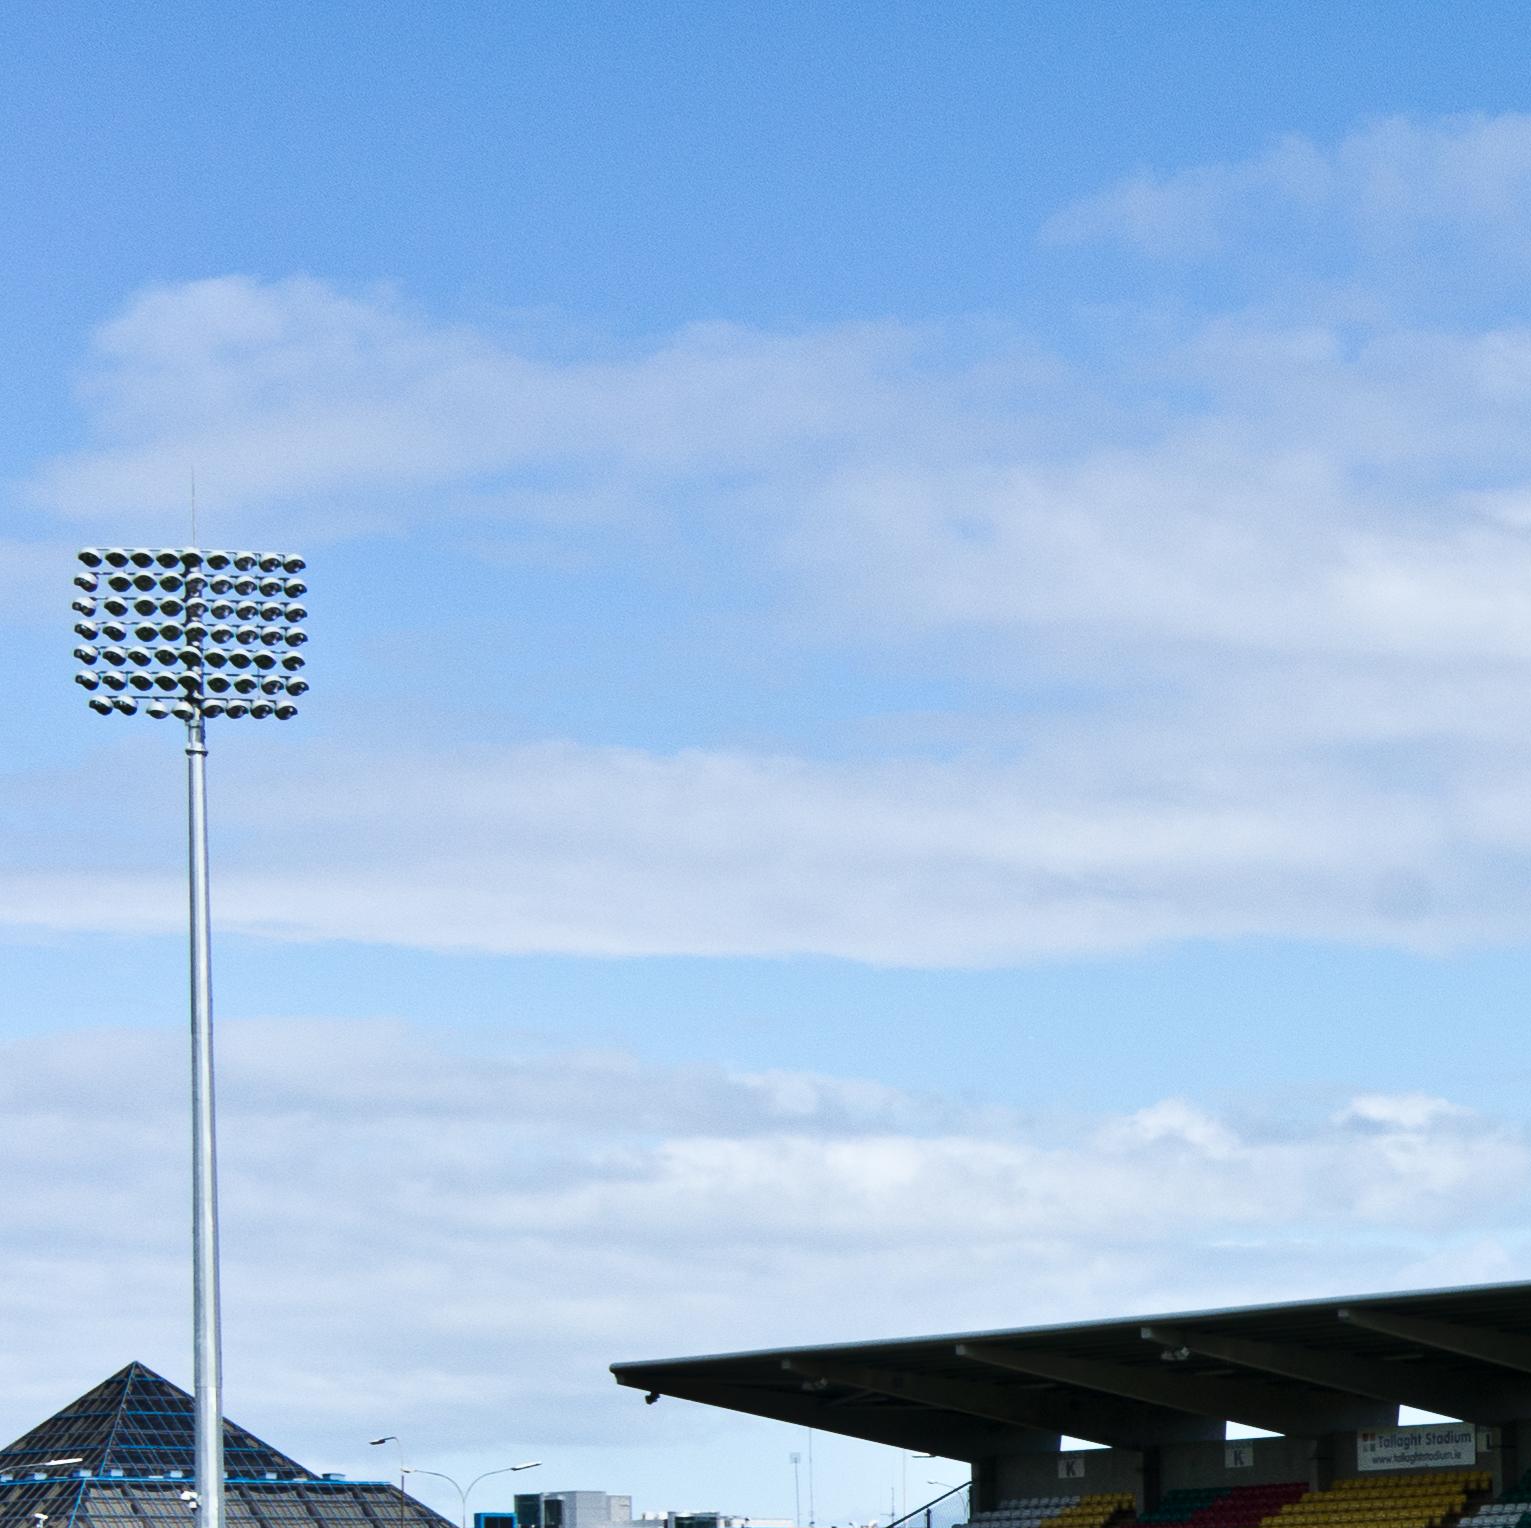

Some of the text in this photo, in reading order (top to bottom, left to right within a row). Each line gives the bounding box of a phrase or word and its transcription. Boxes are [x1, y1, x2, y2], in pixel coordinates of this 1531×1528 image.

[1378, 1431, 1471, 1450] Tallaght Stadium
[1233, 1450, 1244, 1466] K
[1065, 1461, 1076, 1477] K
